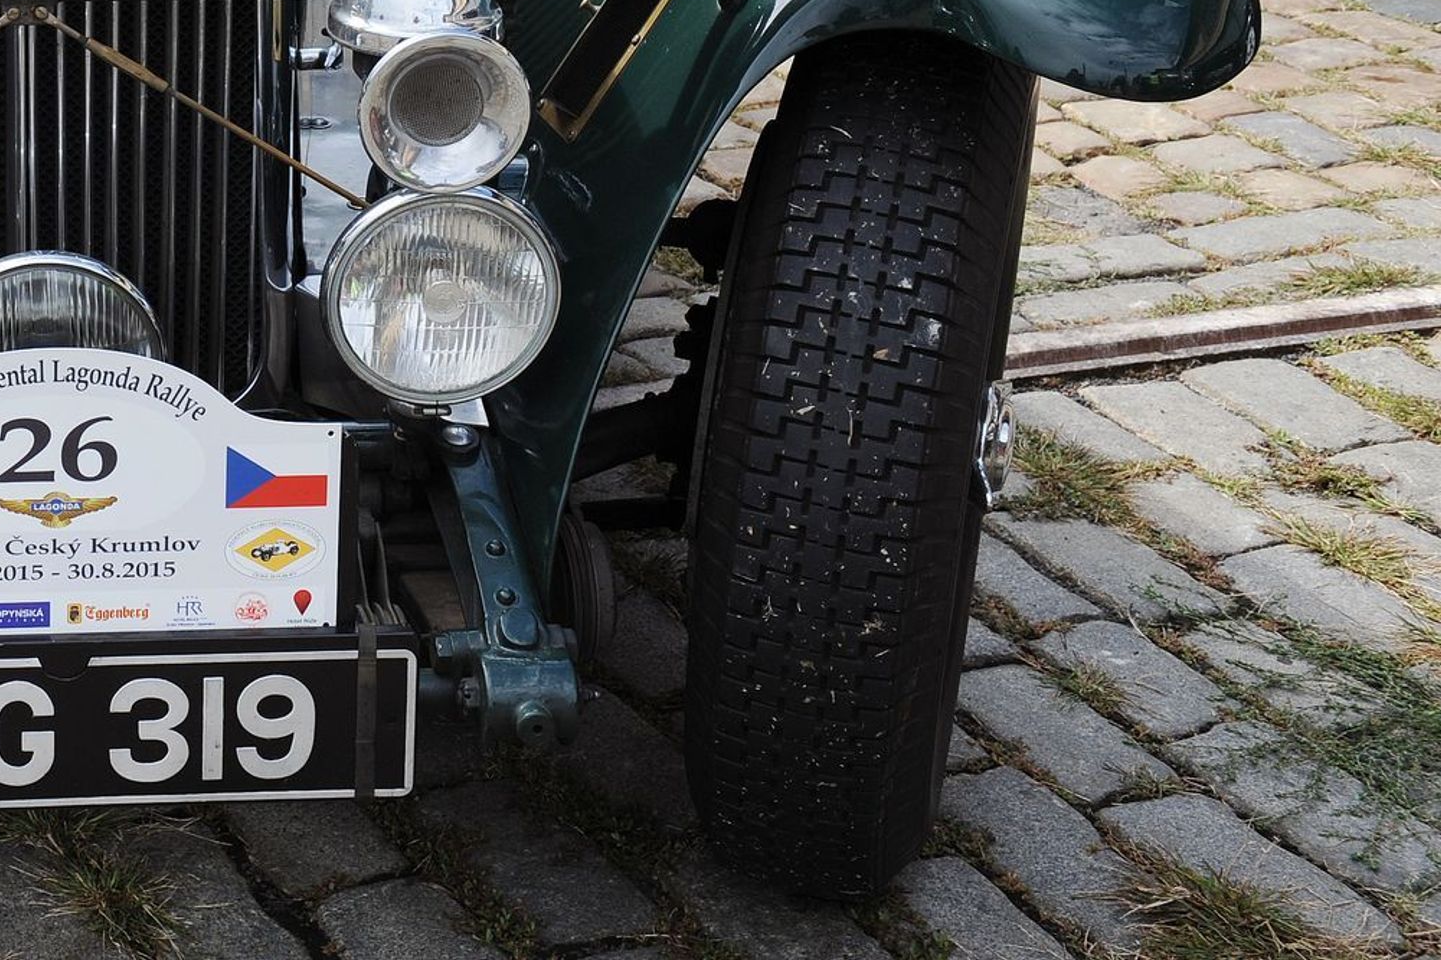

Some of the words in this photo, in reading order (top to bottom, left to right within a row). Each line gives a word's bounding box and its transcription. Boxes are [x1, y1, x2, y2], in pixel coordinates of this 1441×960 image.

[52, 359, 140, 392] Lagonda
[143, 373, 207, 422] Rallye
[32, 500, 81, 512] LAGONDA
[4, 535, 82, 559] Český
[90, 535, 202, 555] Krumlov
[67, 561, 177, 581] 30.8.2015
[85, 604, 150, 622] Eggenberg
[108, 673, 318, 784] 319
